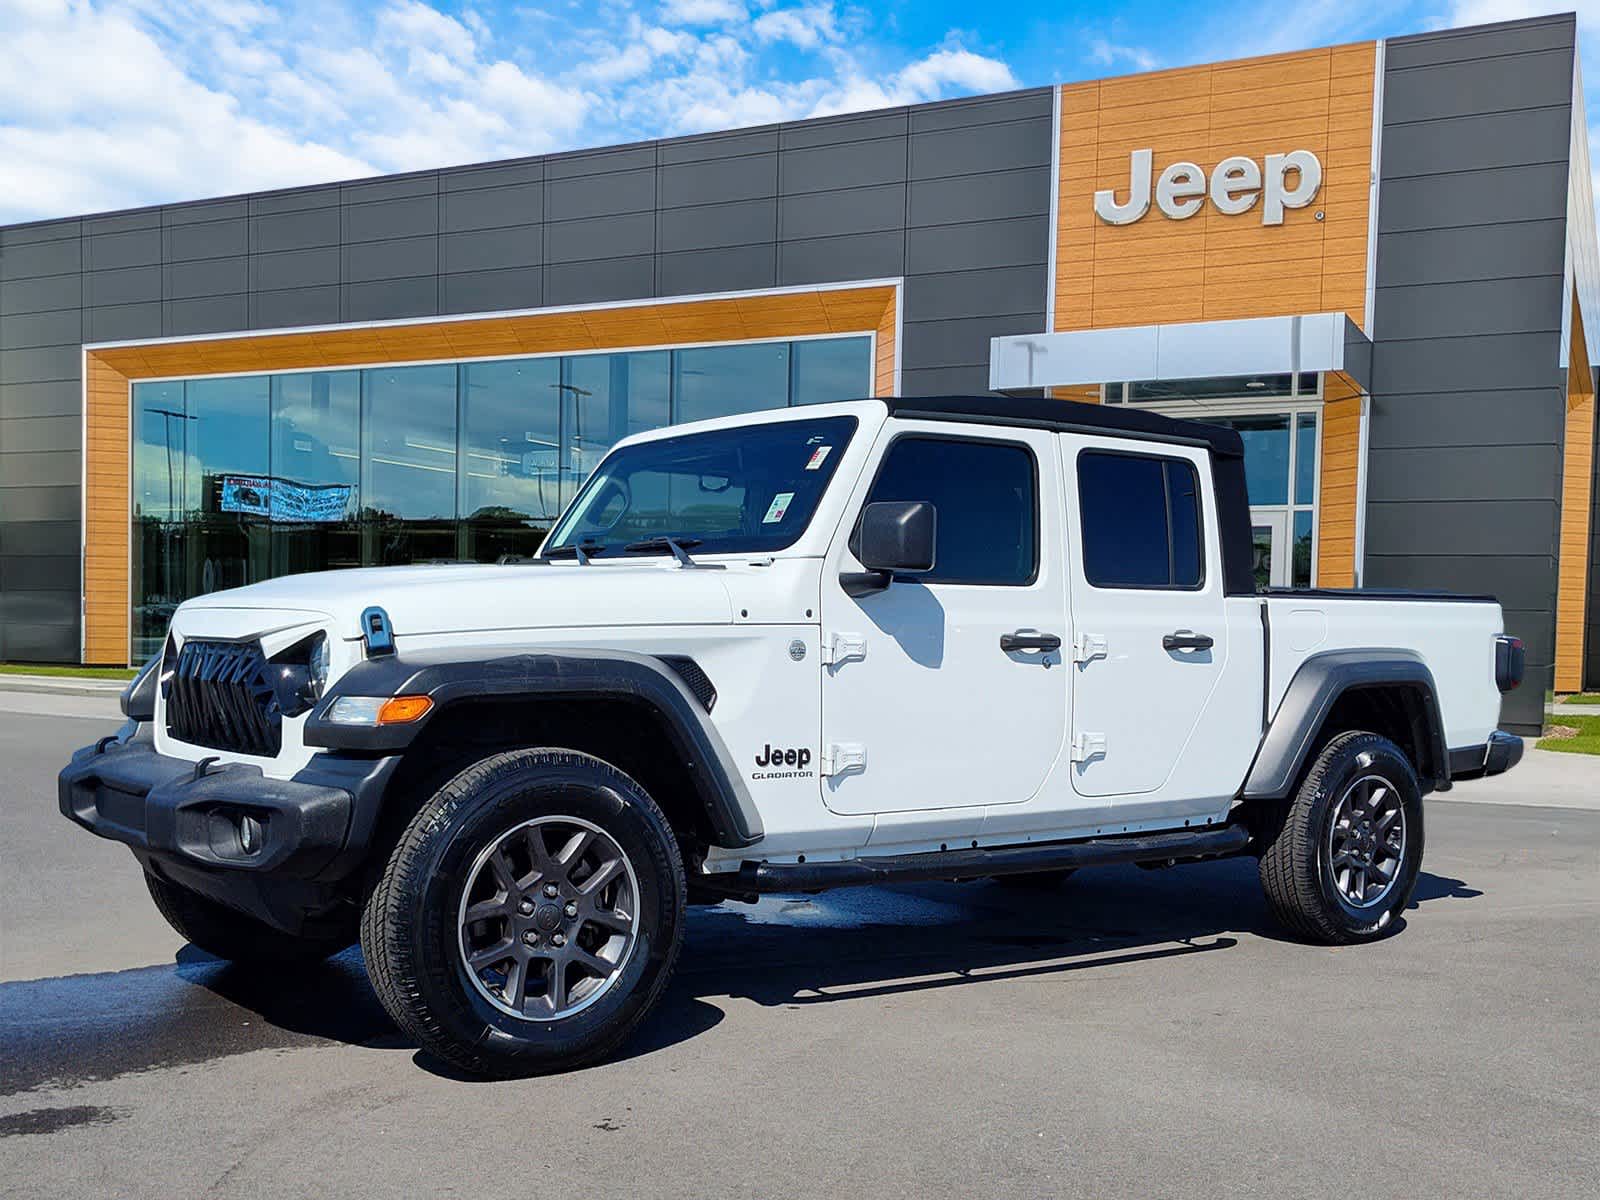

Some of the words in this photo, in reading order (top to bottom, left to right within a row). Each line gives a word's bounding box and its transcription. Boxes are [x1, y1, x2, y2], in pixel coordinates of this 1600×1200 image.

[1094, 148, 1322, 226] Jeep
[755, 744, 811, 769] Jeep
[752, 771, 814, 780] GLADIATOR
